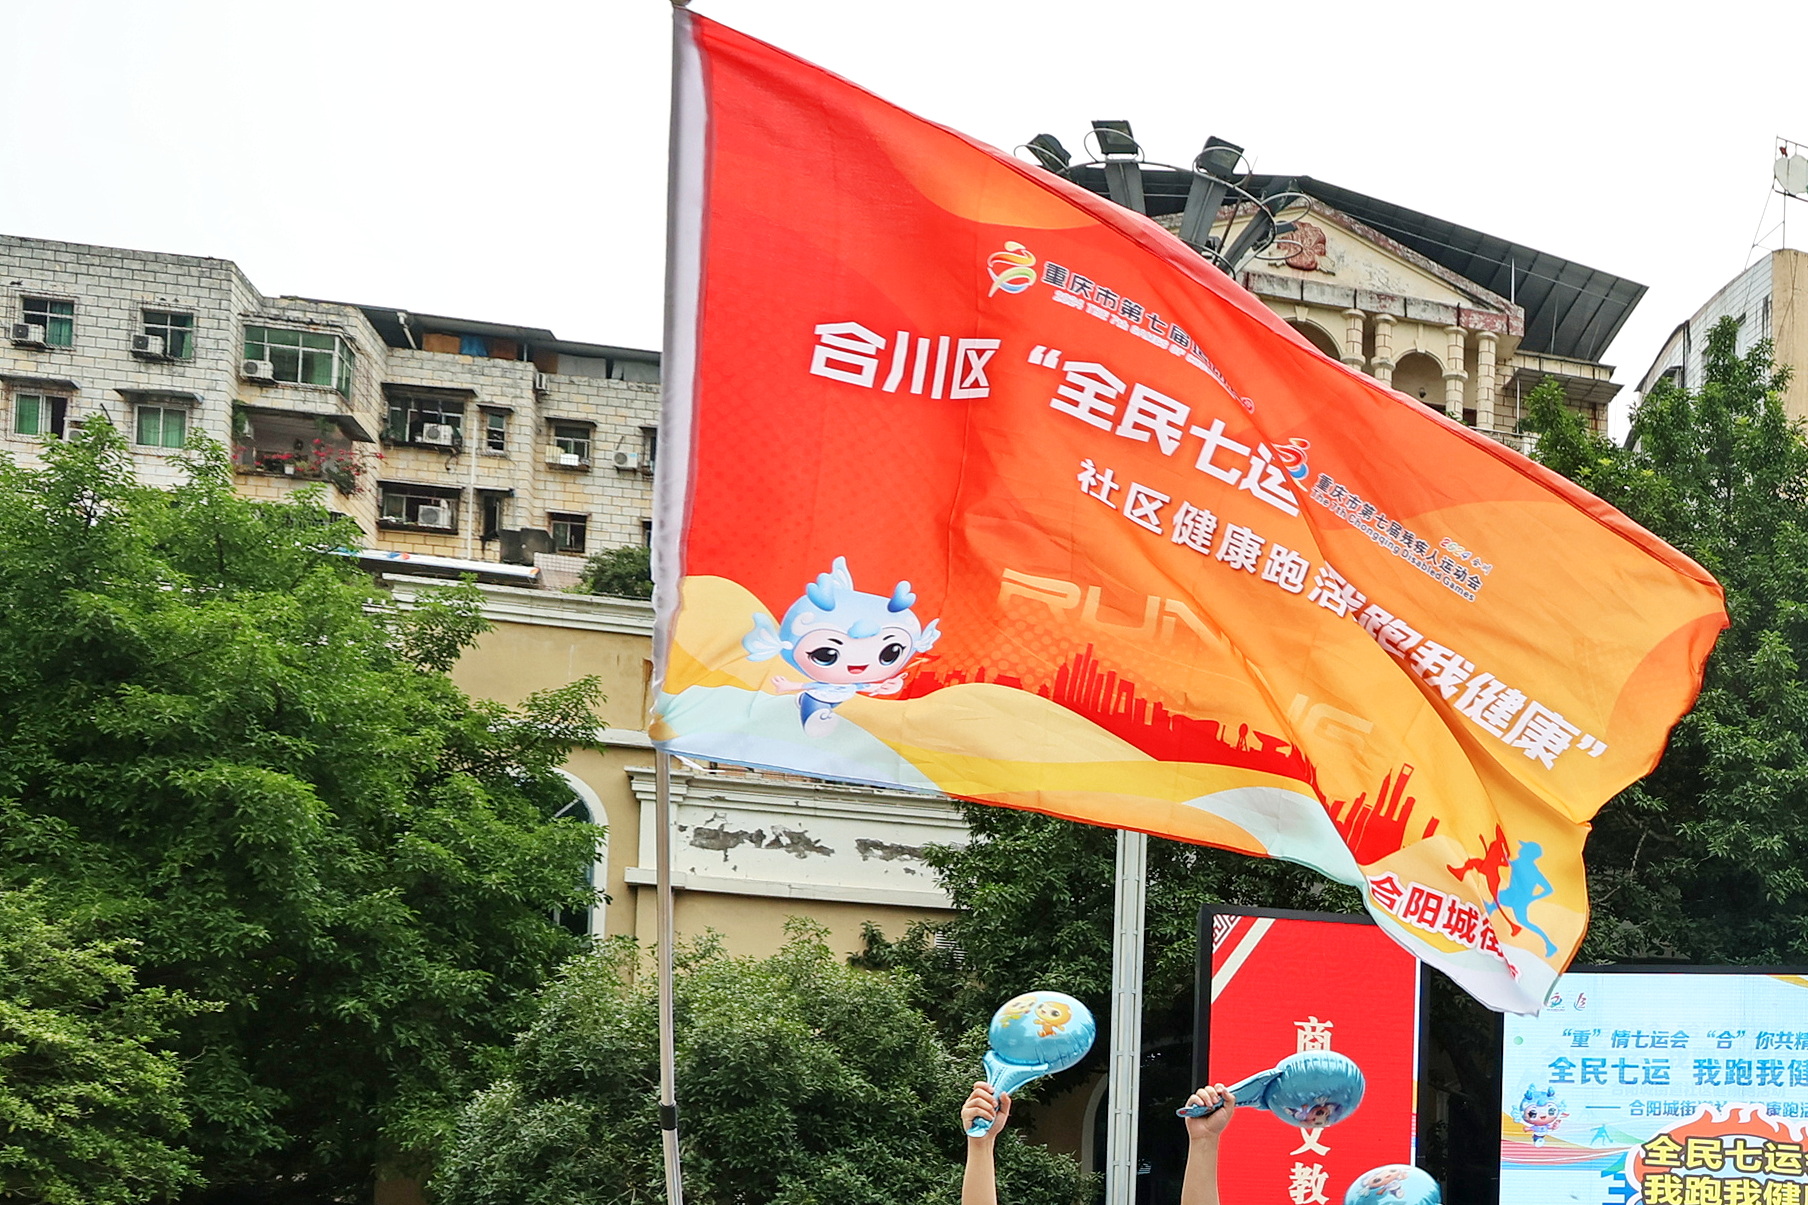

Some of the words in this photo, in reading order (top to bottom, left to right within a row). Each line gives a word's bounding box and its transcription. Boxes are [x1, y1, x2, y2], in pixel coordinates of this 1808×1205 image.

[808, 320, 1000, 401] 合川区
[1310, 487, 1331, 507] The
[1330, 500, 1348, 519] 7th
[1347, 511, 1401, 557] Chongqing
[1400, 547, 1443, 582] Disabled
[1442, 571, 1477, 602] Games
[1316, 473, 1483, 591] 重庆市第七届残疾人运动会
[1548, 1056, 1671, 1086] 全民七运
